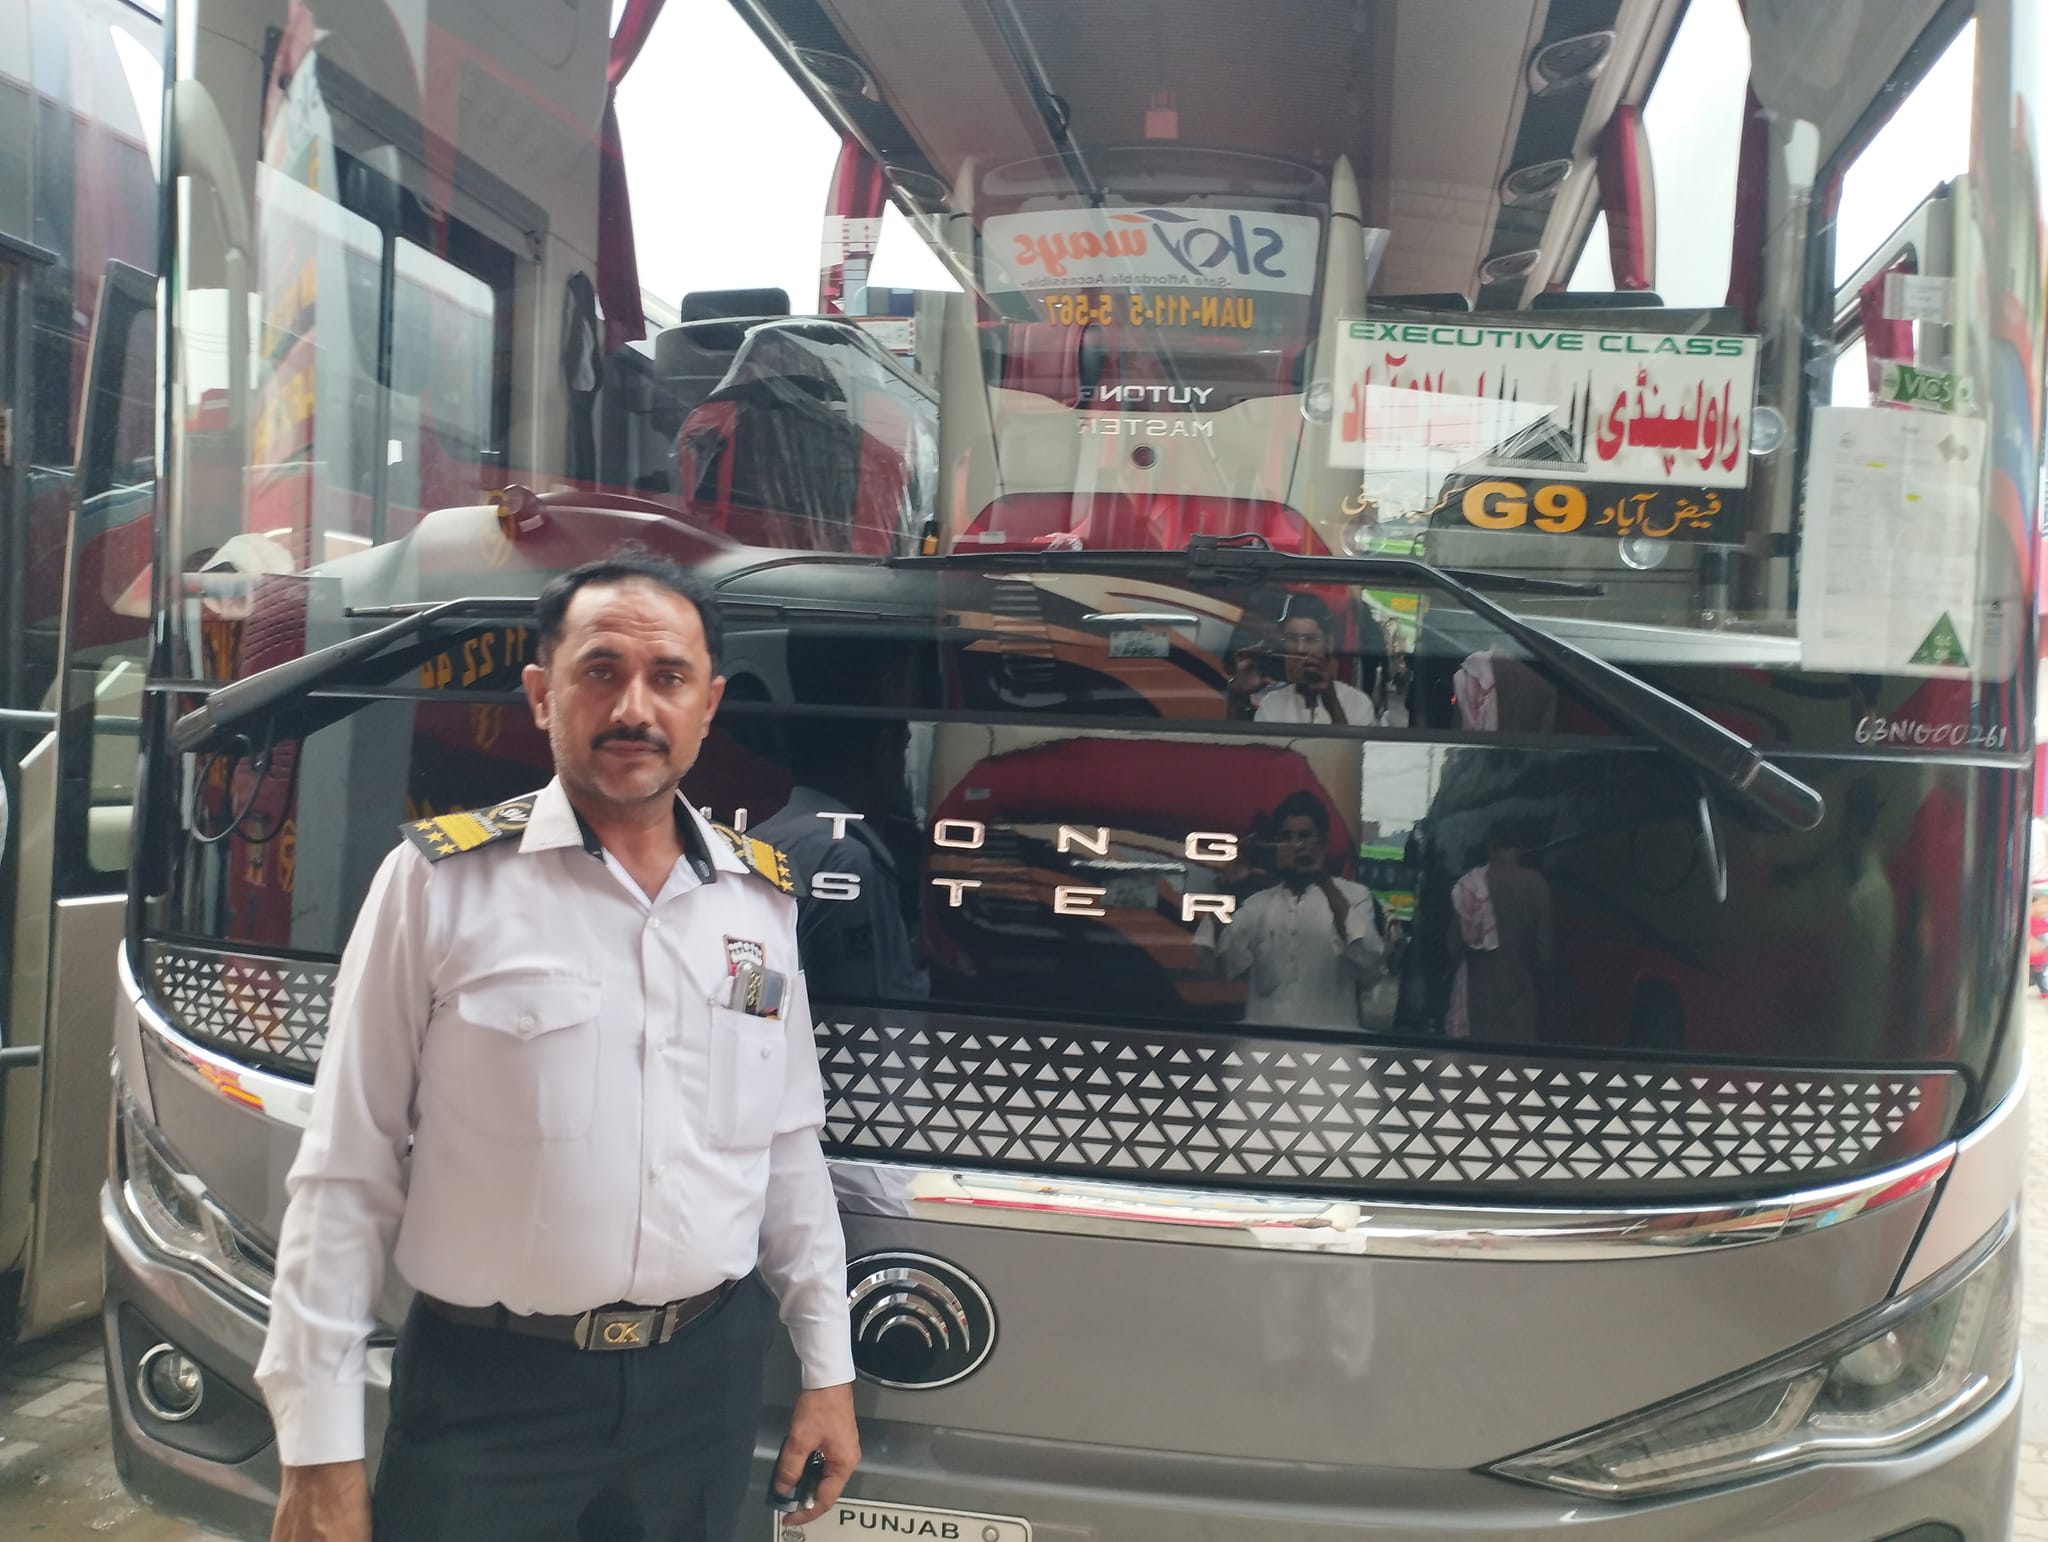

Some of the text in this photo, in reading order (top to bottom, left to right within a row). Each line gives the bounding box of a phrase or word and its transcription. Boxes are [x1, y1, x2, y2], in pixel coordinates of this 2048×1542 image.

[1349, 322, 1745, 357] EXECUTIVE CLASS
[1461, 481, 1588, 534] G9
[811, 871, 1237, 926] STER
[838, 1509, 961, 1541] PUNJAB
